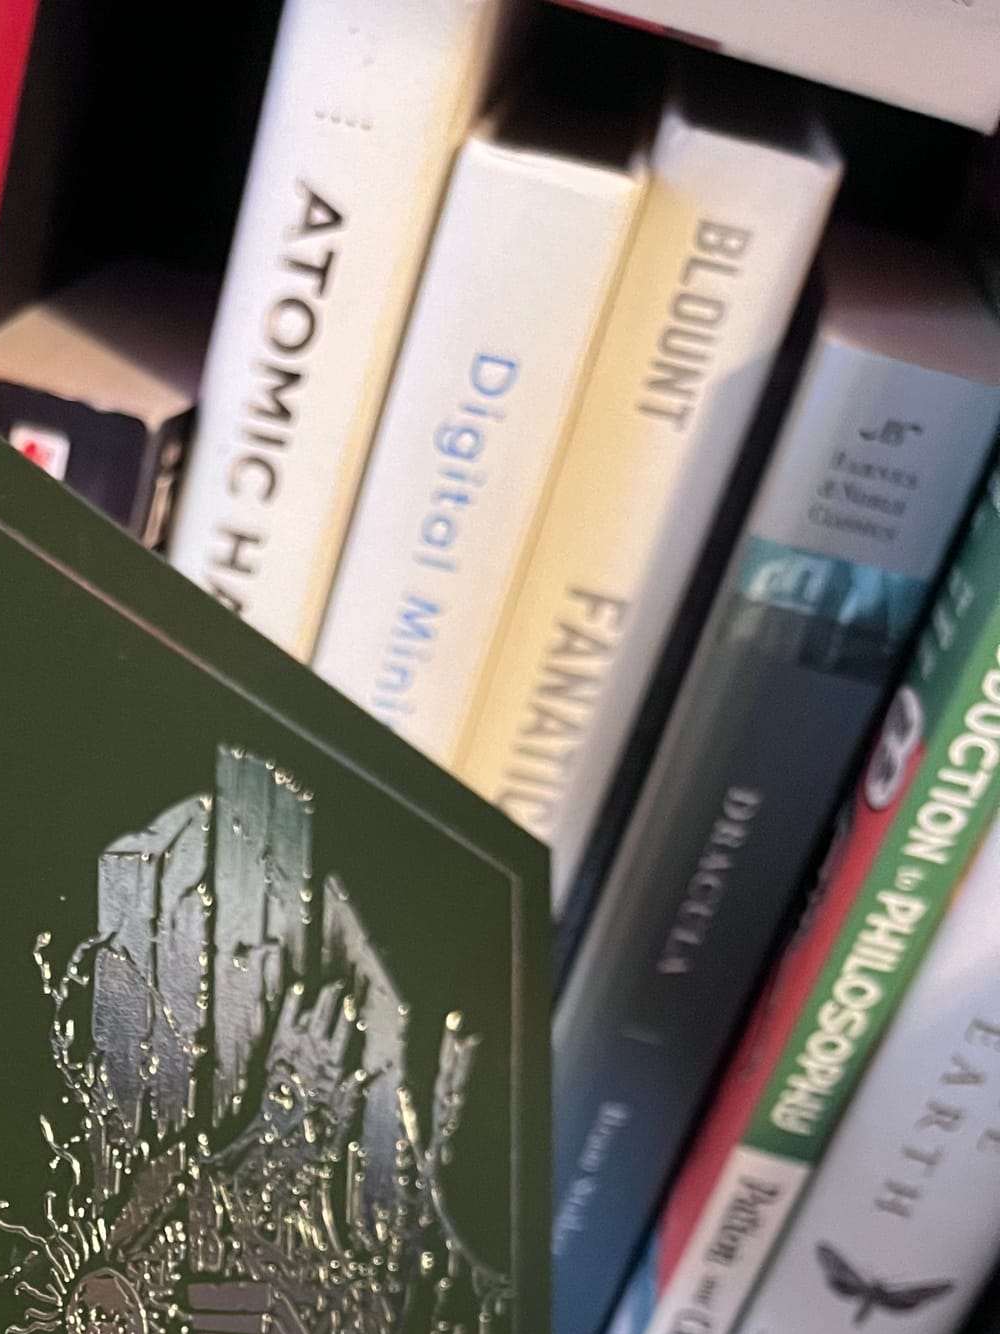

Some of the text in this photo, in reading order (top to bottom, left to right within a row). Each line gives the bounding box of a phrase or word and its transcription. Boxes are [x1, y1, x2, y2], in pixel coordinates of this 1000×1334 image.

[228, 176, 345, 501] ATOMIC
[636, 218, 755, 435] BLOUNT
[413, 354, 518, 574] Digital
